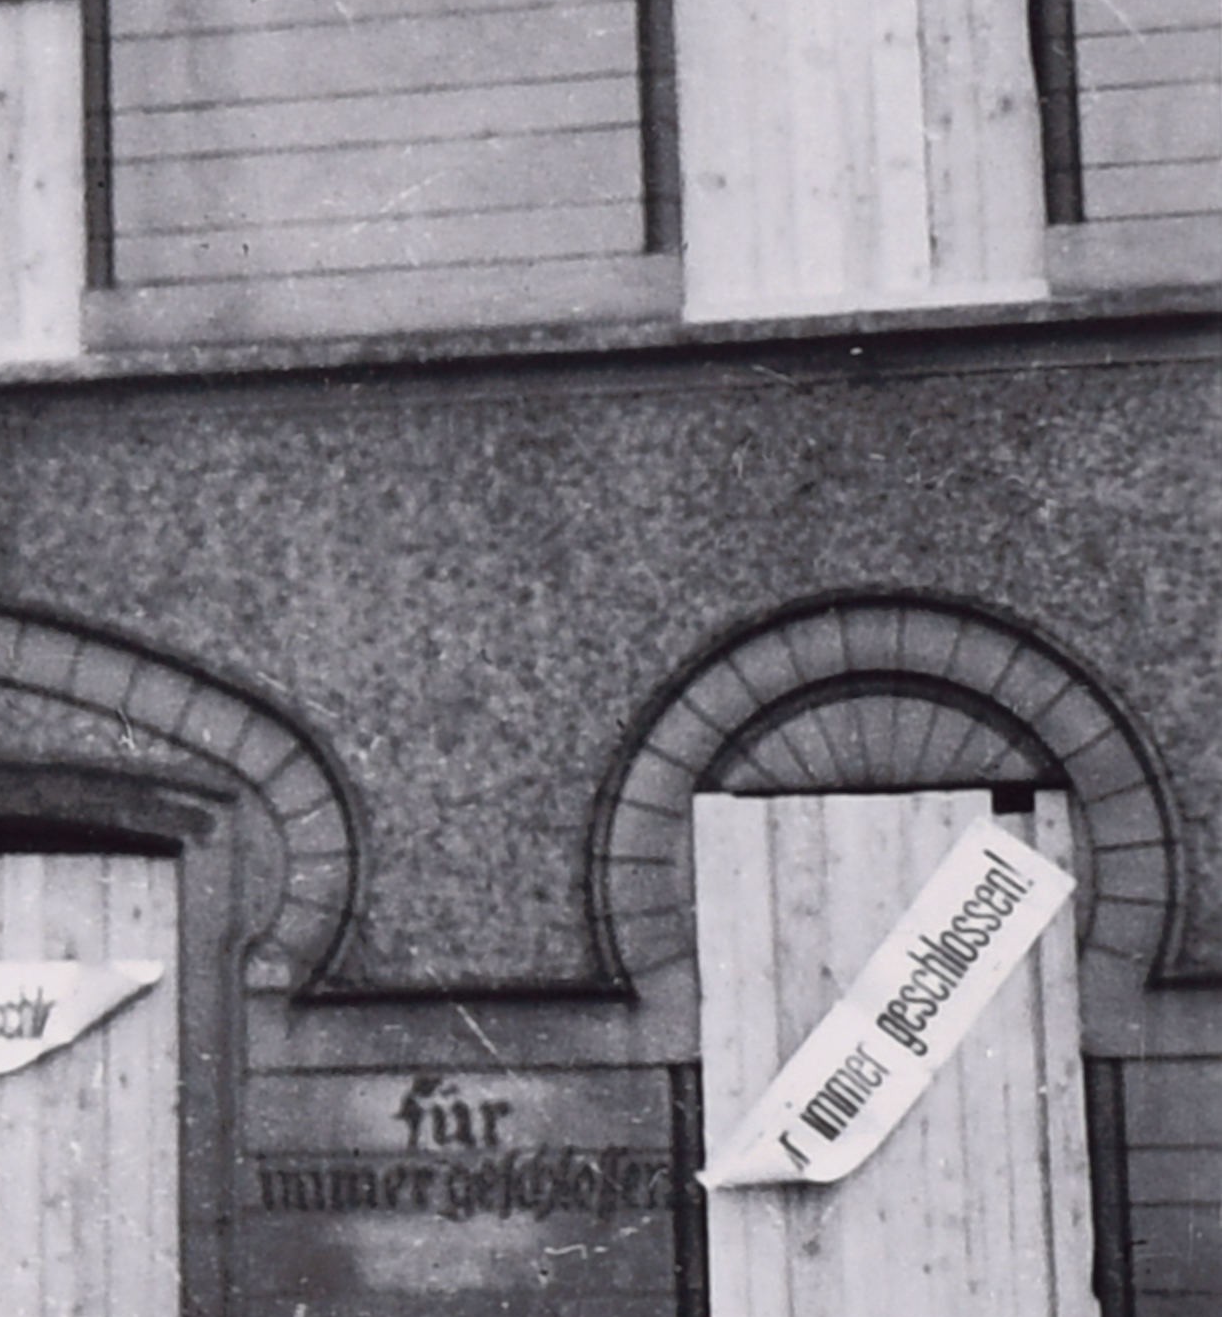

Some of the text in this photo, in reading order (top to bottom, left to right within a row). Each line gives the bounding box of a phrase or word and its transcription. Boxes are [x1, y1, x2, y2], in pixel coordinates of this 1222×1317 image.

[783, 1041, 890, 1142] immer
[875, 848, 1035, 1057] geschlossen!
[394, 1076, 511, 1148] für
